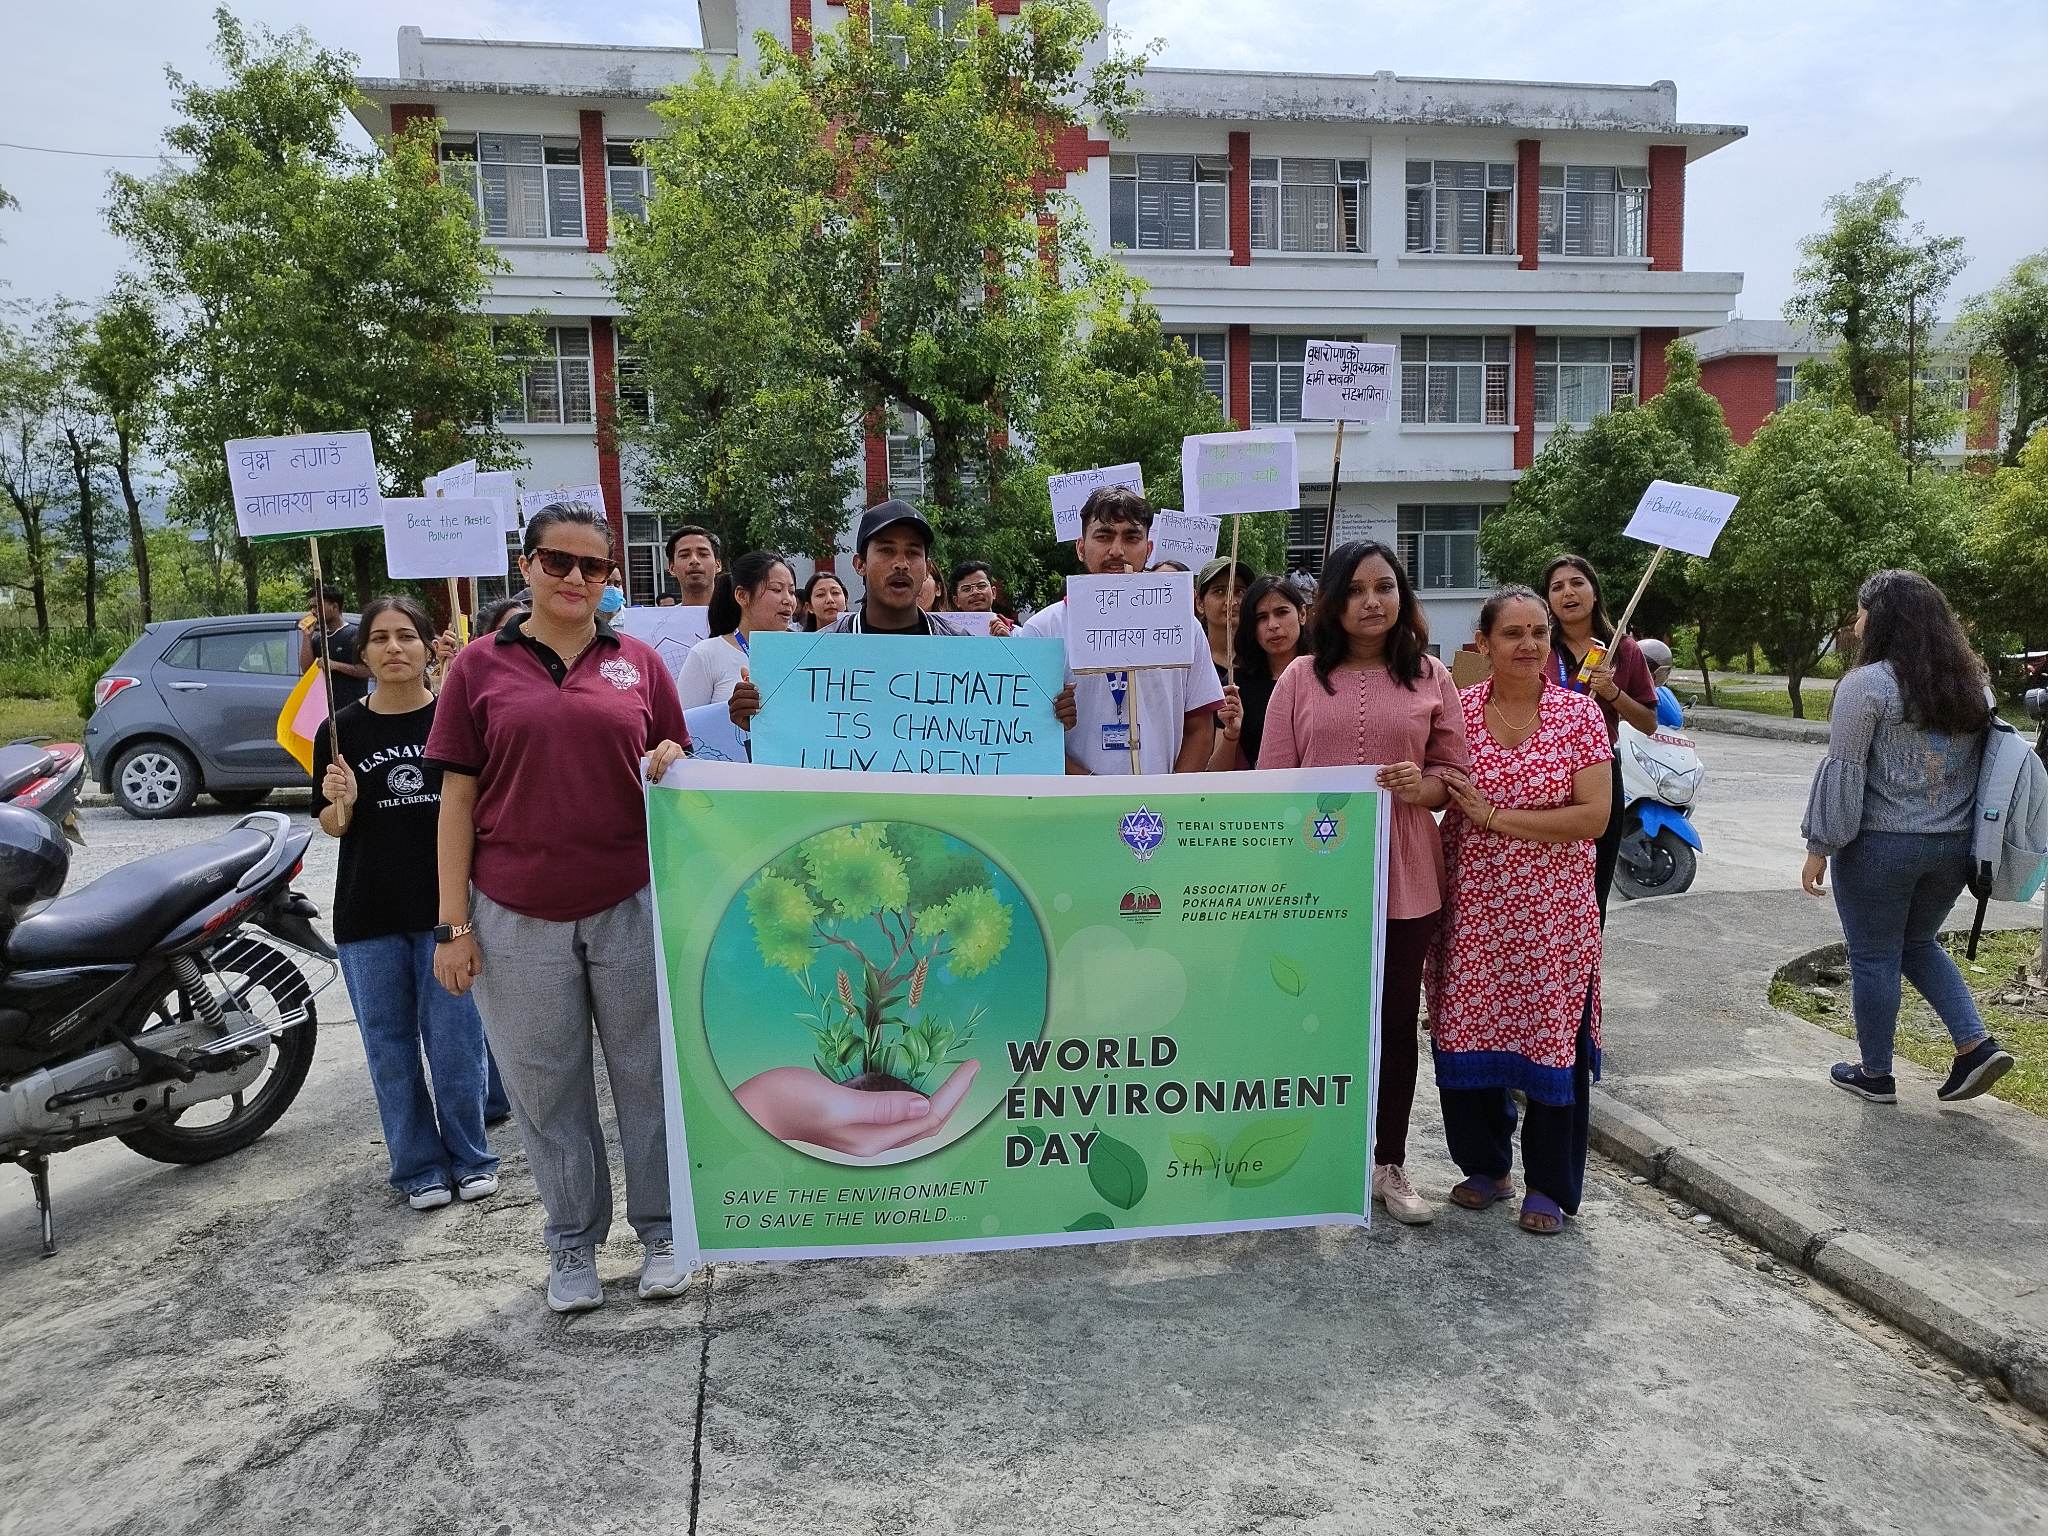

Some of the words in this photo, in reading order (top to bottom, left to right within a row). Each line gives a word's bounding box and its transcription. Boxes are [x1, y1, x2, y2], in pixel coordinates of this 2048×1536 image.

[239, 450, 276, 479] वृक्ष
[245, 490, 325, 517] वातावरण
[407, 513, 431, 529] Beat
[440, 515, 459, 528] the
[464, 515, 492, 526] Plastic
[428, 531, 463, 542] Pollution
[1095, 589, 1125, 615] वृक्ष
[1085, 628, 1147, 652] वातावरण
[797, 667, 875, 703] THE
[888, 670, 1031, 707] CLIMATE
[825, 711, 872, 739] IS
[893, 713, 1033, 745] CHANGING
[358, 744, 425, 773] U.S.NAV
[1177, 821, 1214, 831] TERAI
[1219, 821, 1285, 831] STUDENTS
[1177, 837, 1237, 847] WELFARE
[1242, 837, 1295, 847] SOCIETY
[1183, 884, 1267, 895] ASSOCIATION
[1271, 883, 1287, 893] OF
[1182, 898, 1242, 908] POKHARA
[1246, 896, 1320, 907] UNIVERSITY
[1181, 911, 1226, 922] PUBLIC
[1231, 910, 1278, 921] HEALTH
[1282, 909, 1348, 920] STUDENTS
[1006, 1035, 1178, 1073] WORLD
[1006, 1074, 1353, 1120] ENVIRONMENT
[1006, 1131, 1100, 1168] DAY
[1166, 1159, 1203, 1178] 5th
[1214, 1157, 1264, 1179] june
[723, 1190, 778, 1205] SAVE
[788, 1189, 828, 1204] THE
[837, 1180, 989, 1203] ENVIRONMENT
[723, 1215, 750, 1229] TO
[759, 1213, 814, 1229] SAVE
[824, 1212, 864, 1227] THE
[873, 1208, 967, 1226] WORLD...
